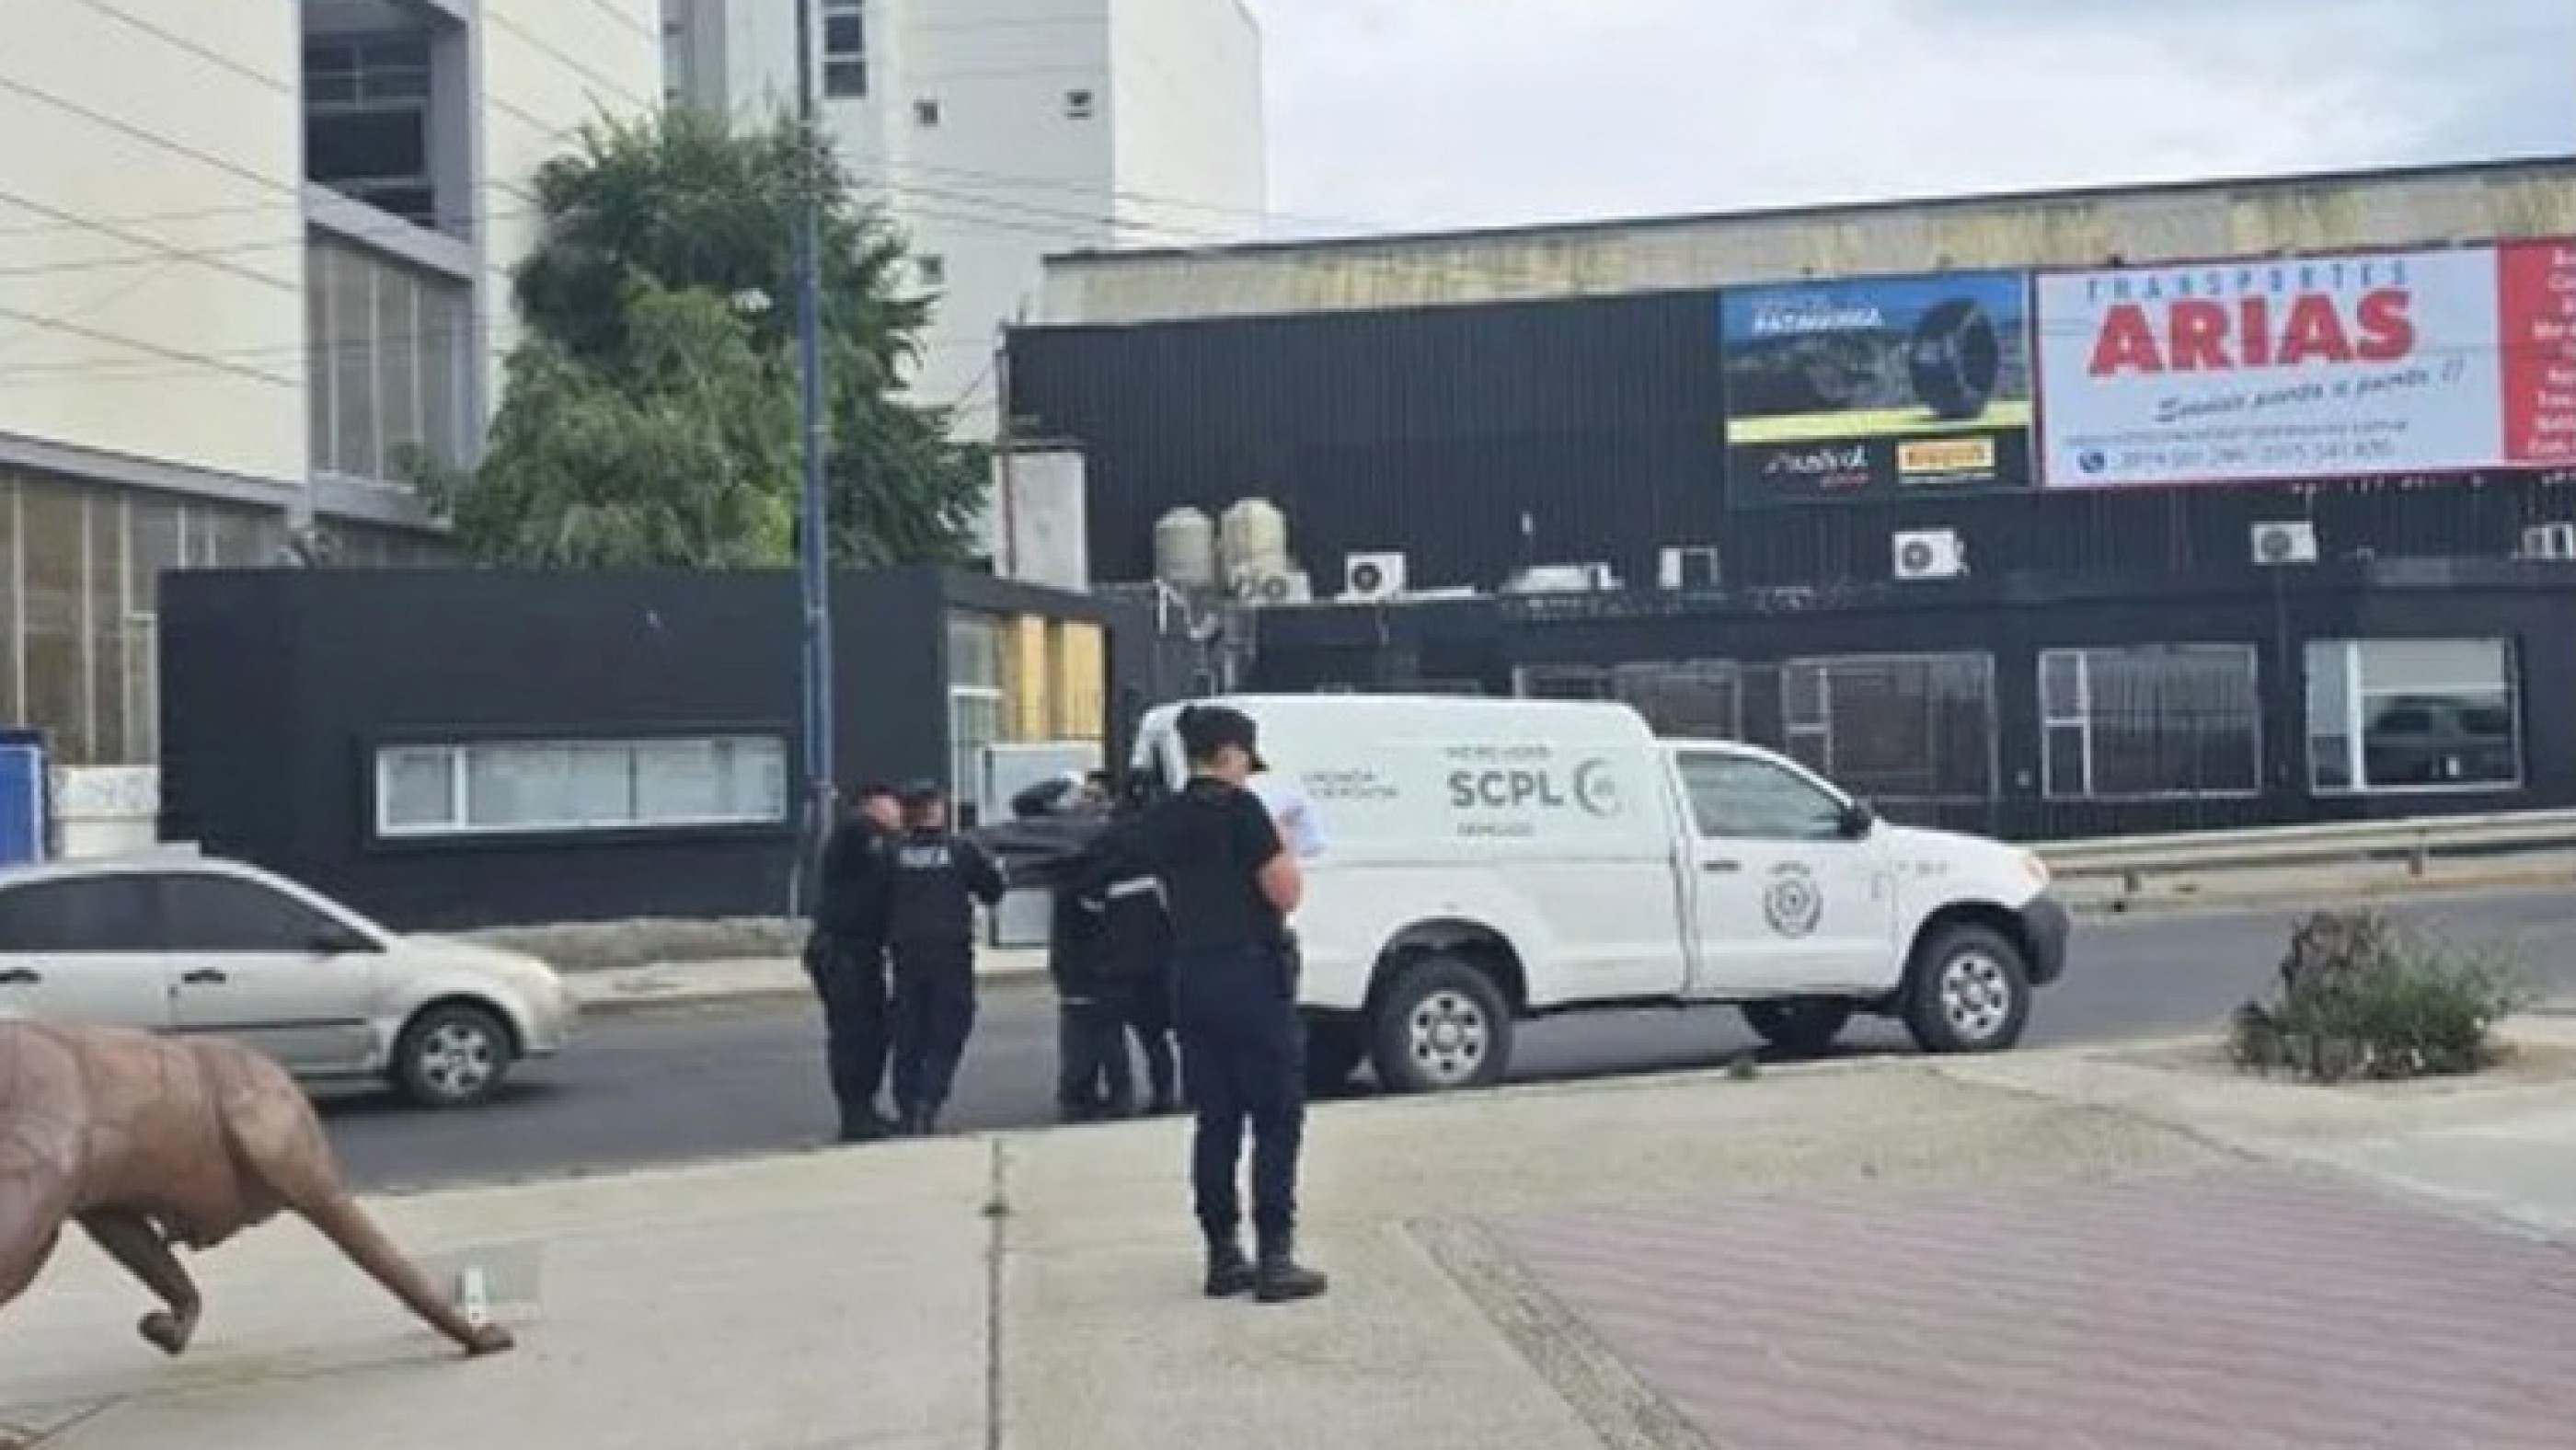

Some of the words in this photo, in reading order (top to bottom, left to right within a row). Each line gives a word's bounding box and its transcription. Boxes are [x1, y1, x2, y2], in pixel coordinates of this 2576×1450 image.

[2087, 261, 2408, 302] TRANSPORTES
[2087, 288, 2416, 375] ARIAS
[1447, 769, 1564, 808] SCPL
